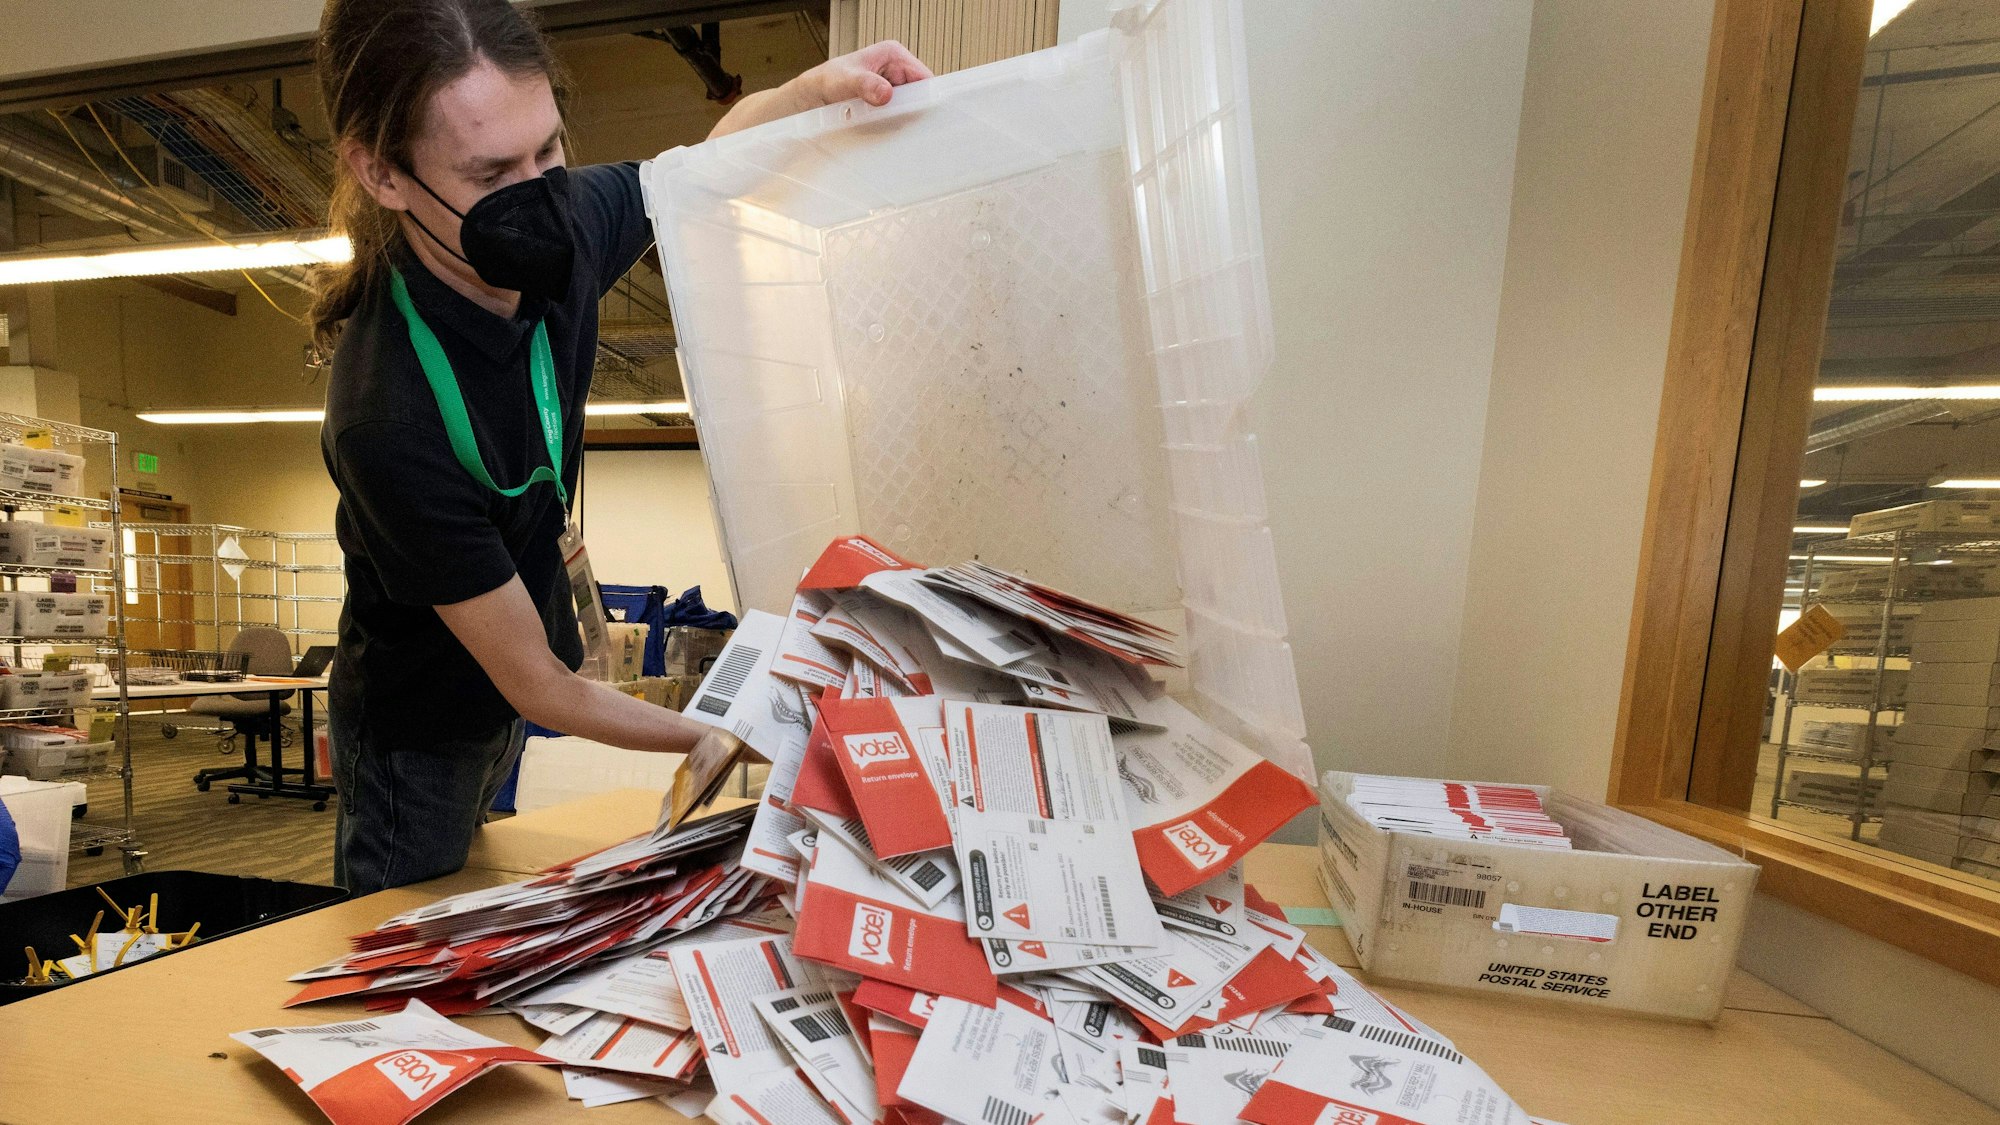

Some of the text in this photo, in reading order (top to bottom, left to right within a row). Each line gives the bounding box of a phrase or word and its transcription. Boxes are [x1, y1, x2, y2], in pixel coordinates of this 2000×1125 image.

[543, 406, 551, 429] County
[138, 452, 158, 474] EXIT
[850, 736, 905, 758] vote!
[861, 772, 919, 784] Return envelope
[1205, 808, 1246, 841] Return envelope
[1168, 824, 1218, 864] vote!
[1000, 850, 1008, 876] possible!
[1476, 874, 1502, 882] 98057
[1642, 883, 1720, 903] LABEL
[1402, 902, 1443, 915] IN-HOUSE
[1636, 902, 1718, 922] OTHER
[861, 906, 886, 956] vote!
[1648, 923, 1698, 940] END
[903, 917, 917, 970] Return envelope
[1488, 962, 1608, 987] UNITED STATES
[687, 979, 695, 993] below
[1224, 983, 1246, 1001] Retur
[1478, 973, 1611, 999] POSTAL SERVICE
[382, 1053, 437, 1091] vote!
[1027, 1058, 1037, 1078] REPLY
[1330, 1104, 1369, 1125] te!
